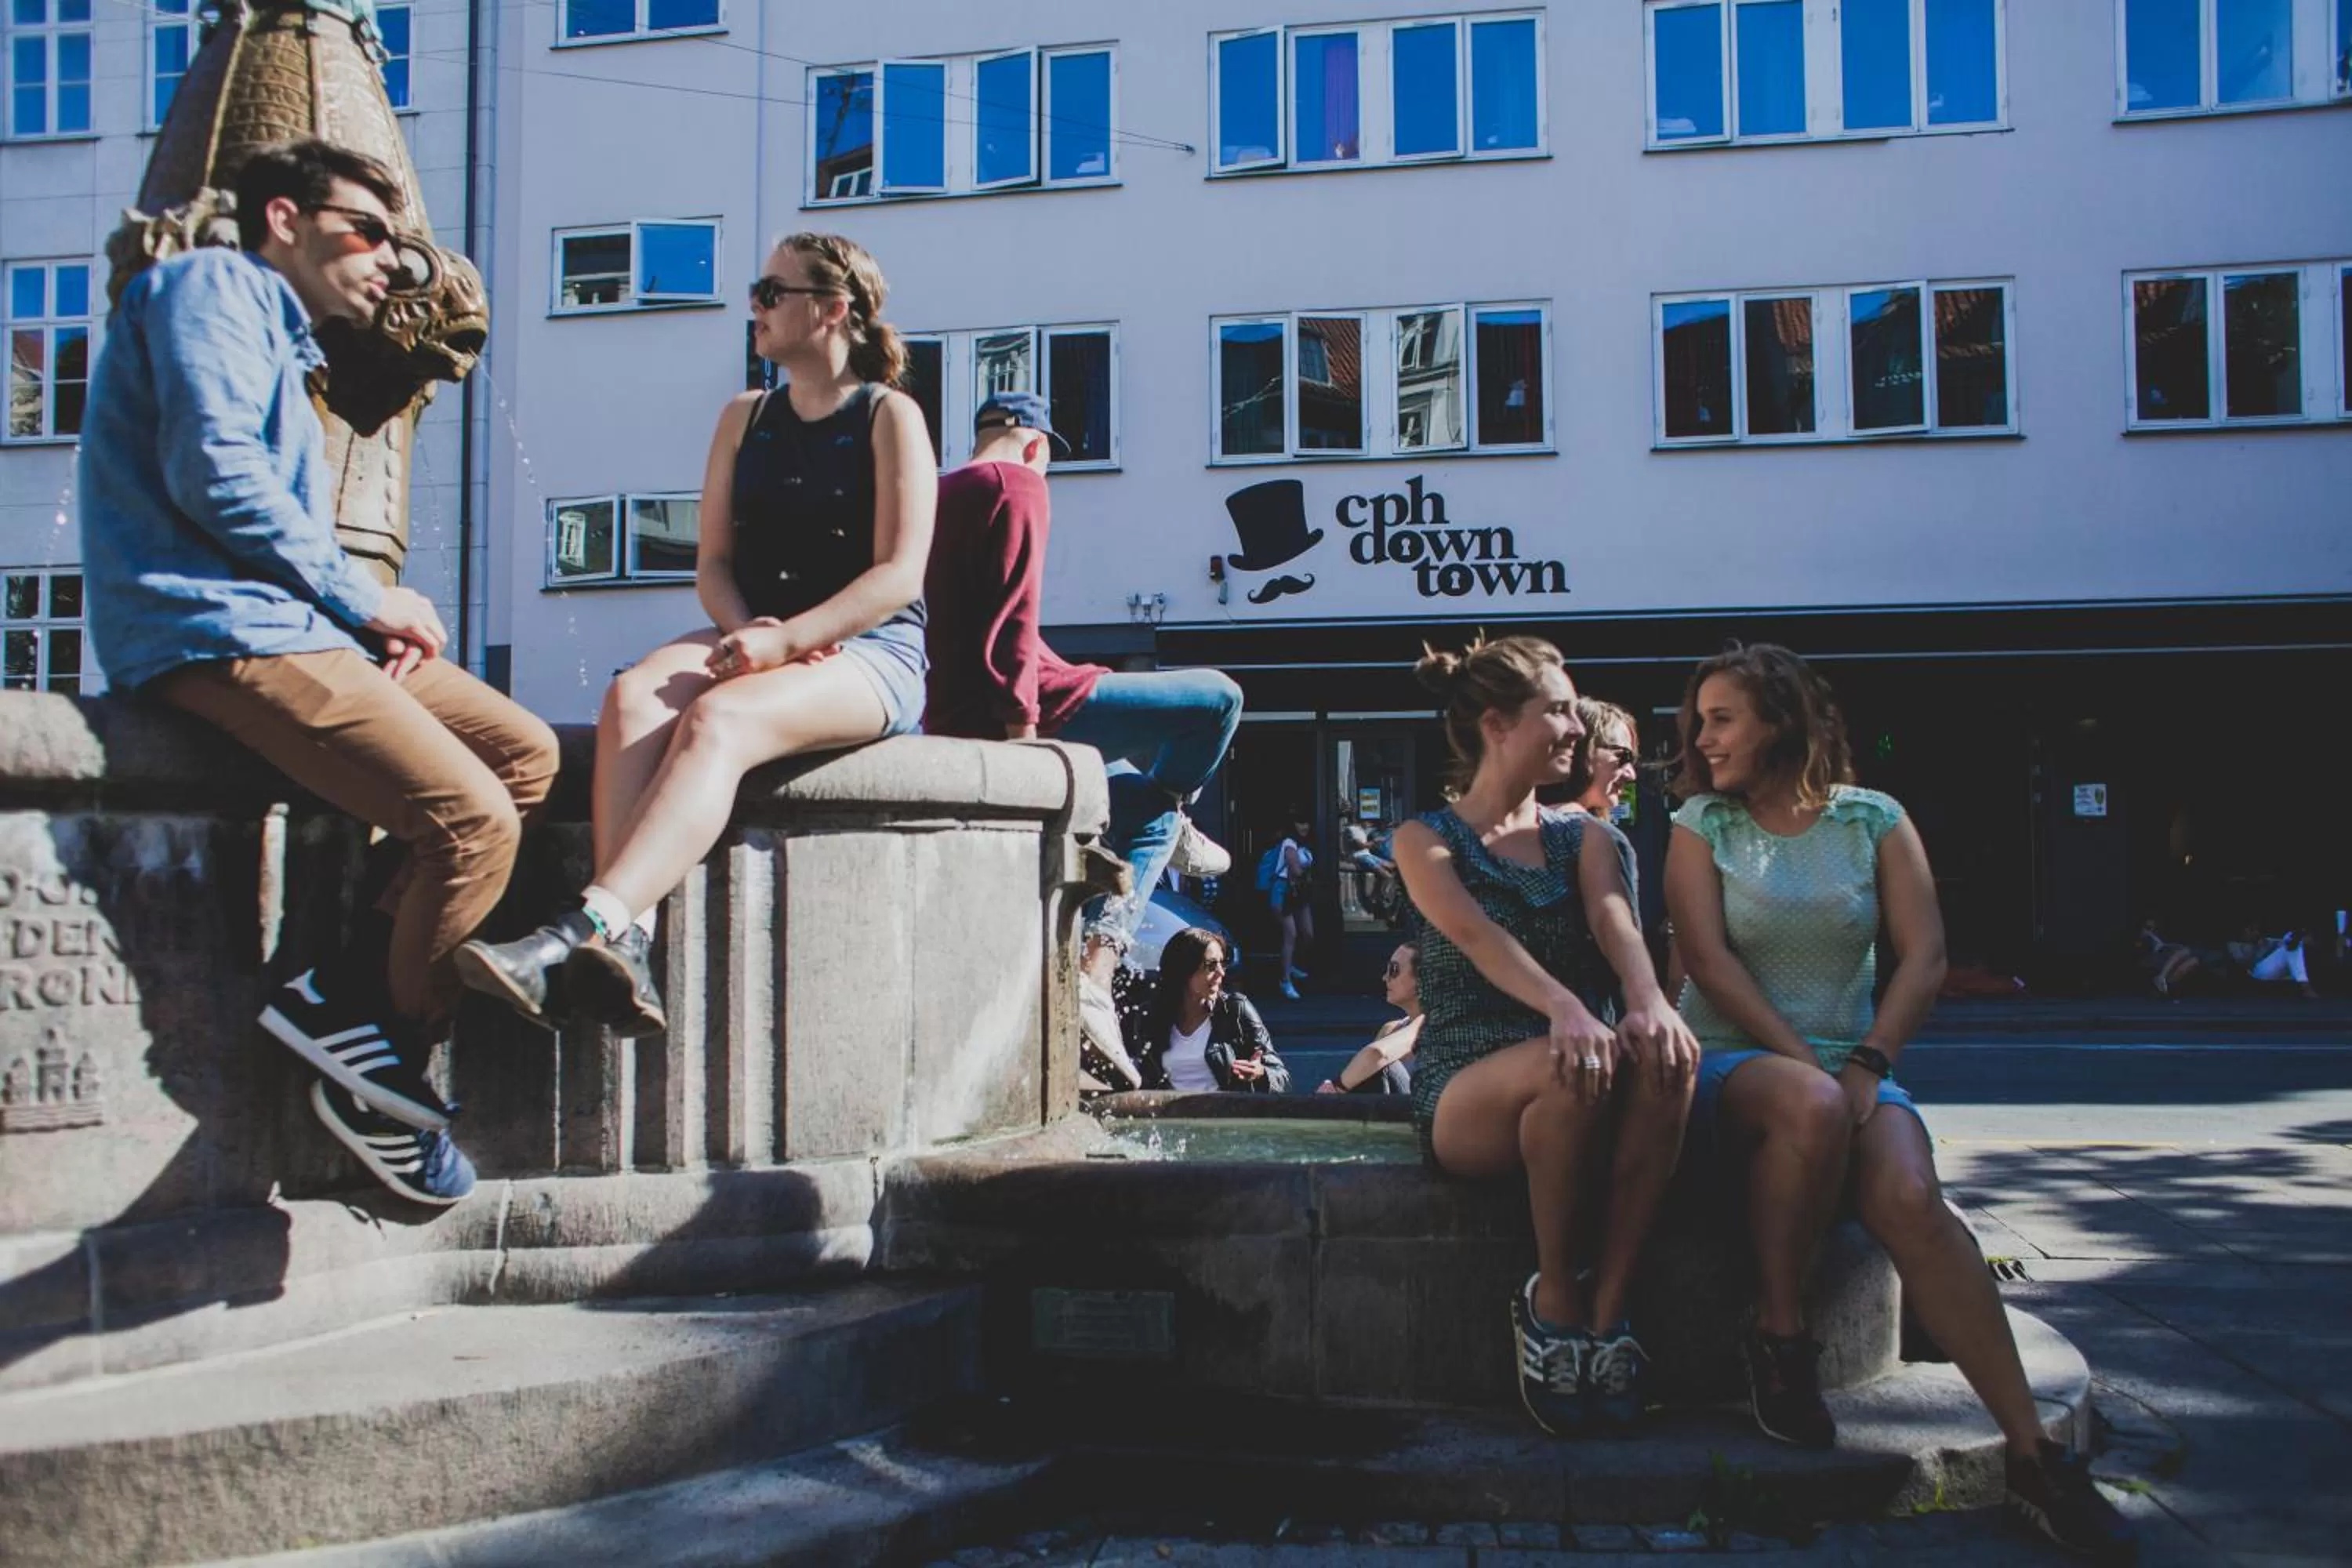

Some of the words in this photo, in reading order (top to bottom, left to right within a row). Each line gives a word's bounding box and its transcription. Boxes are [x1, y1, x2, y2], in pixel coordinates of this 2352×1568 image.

[1335, 474, 1450, 530] cph
[1348, 525, 1519, 565] down
[1411, 556, 1571, 597] town
